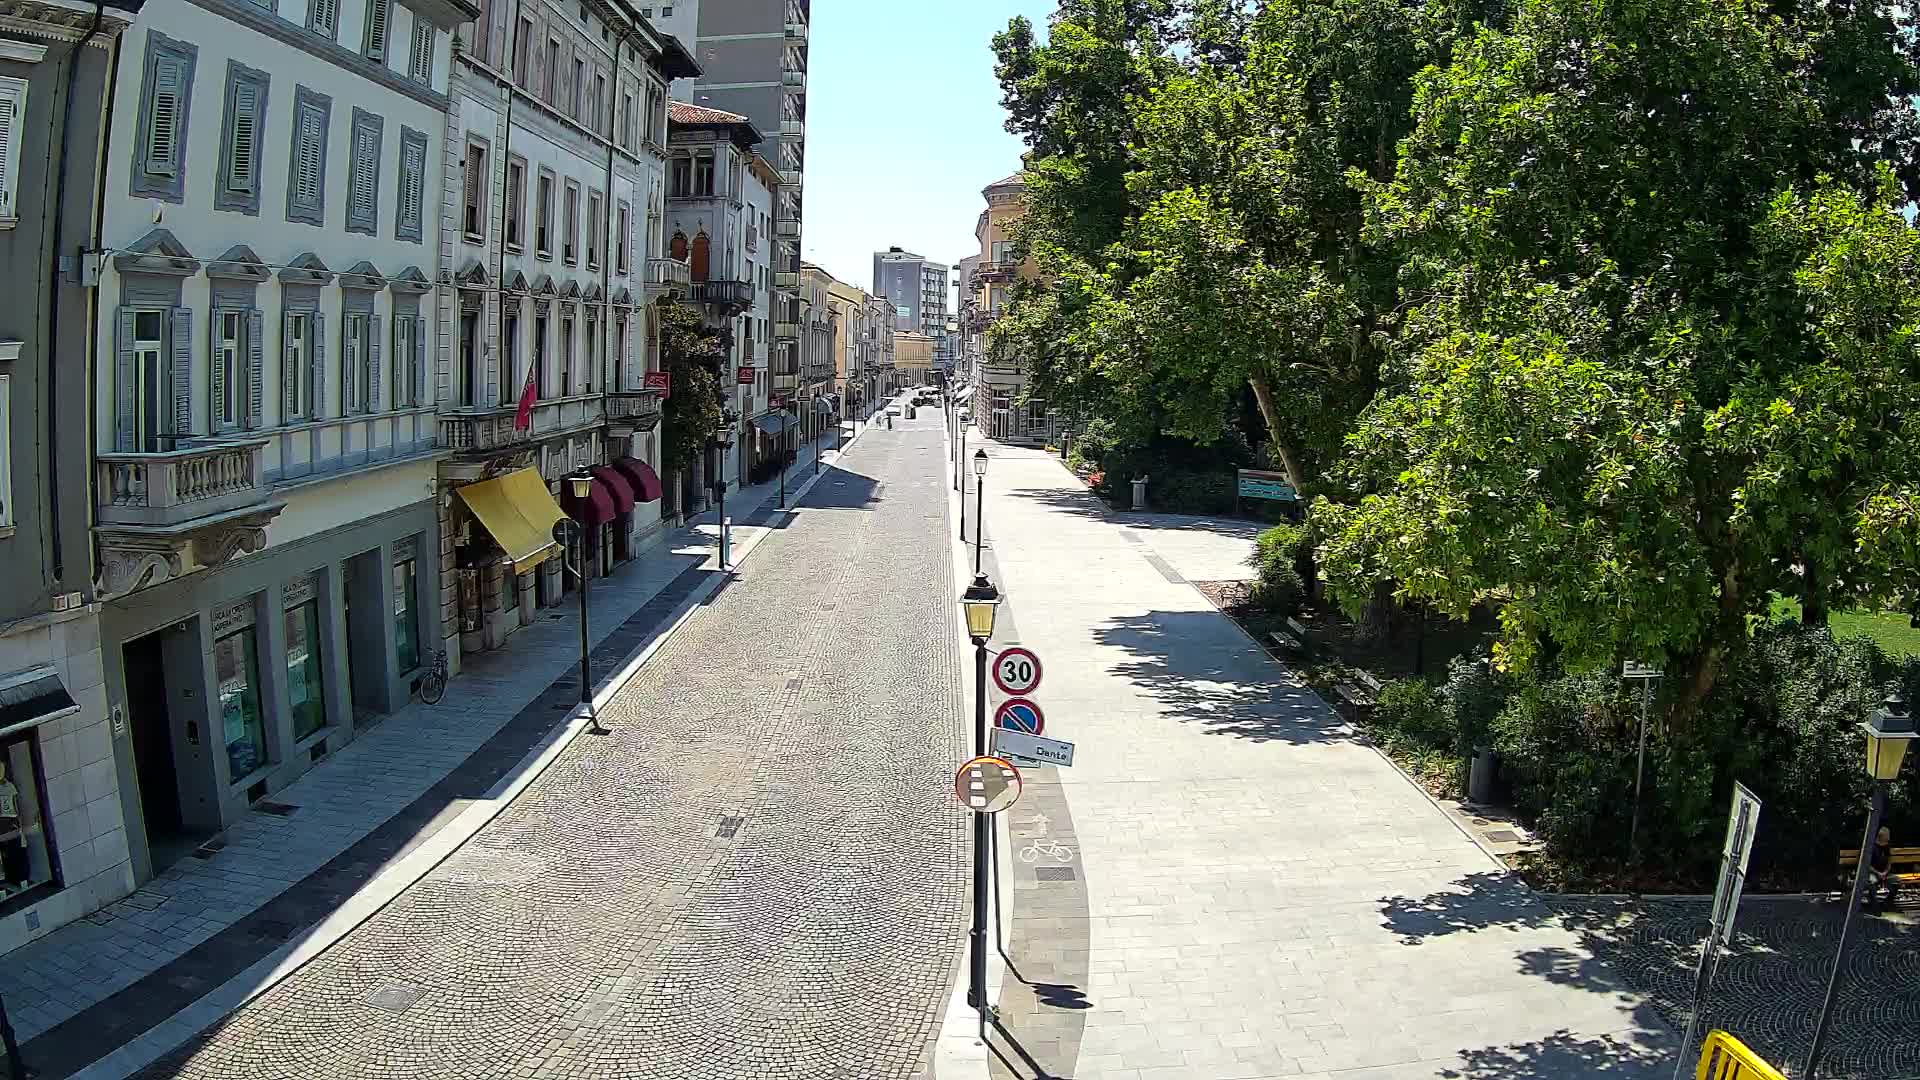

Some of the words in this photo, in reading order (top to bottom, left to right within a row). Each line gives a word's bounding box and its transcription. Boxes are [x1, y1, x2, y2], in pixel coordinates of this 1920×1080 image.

[214, 614, 242, 631] OPERATIVO
[1004, 660, 1032, 683] 30
[1036, 747, 1066, 760] Dante
